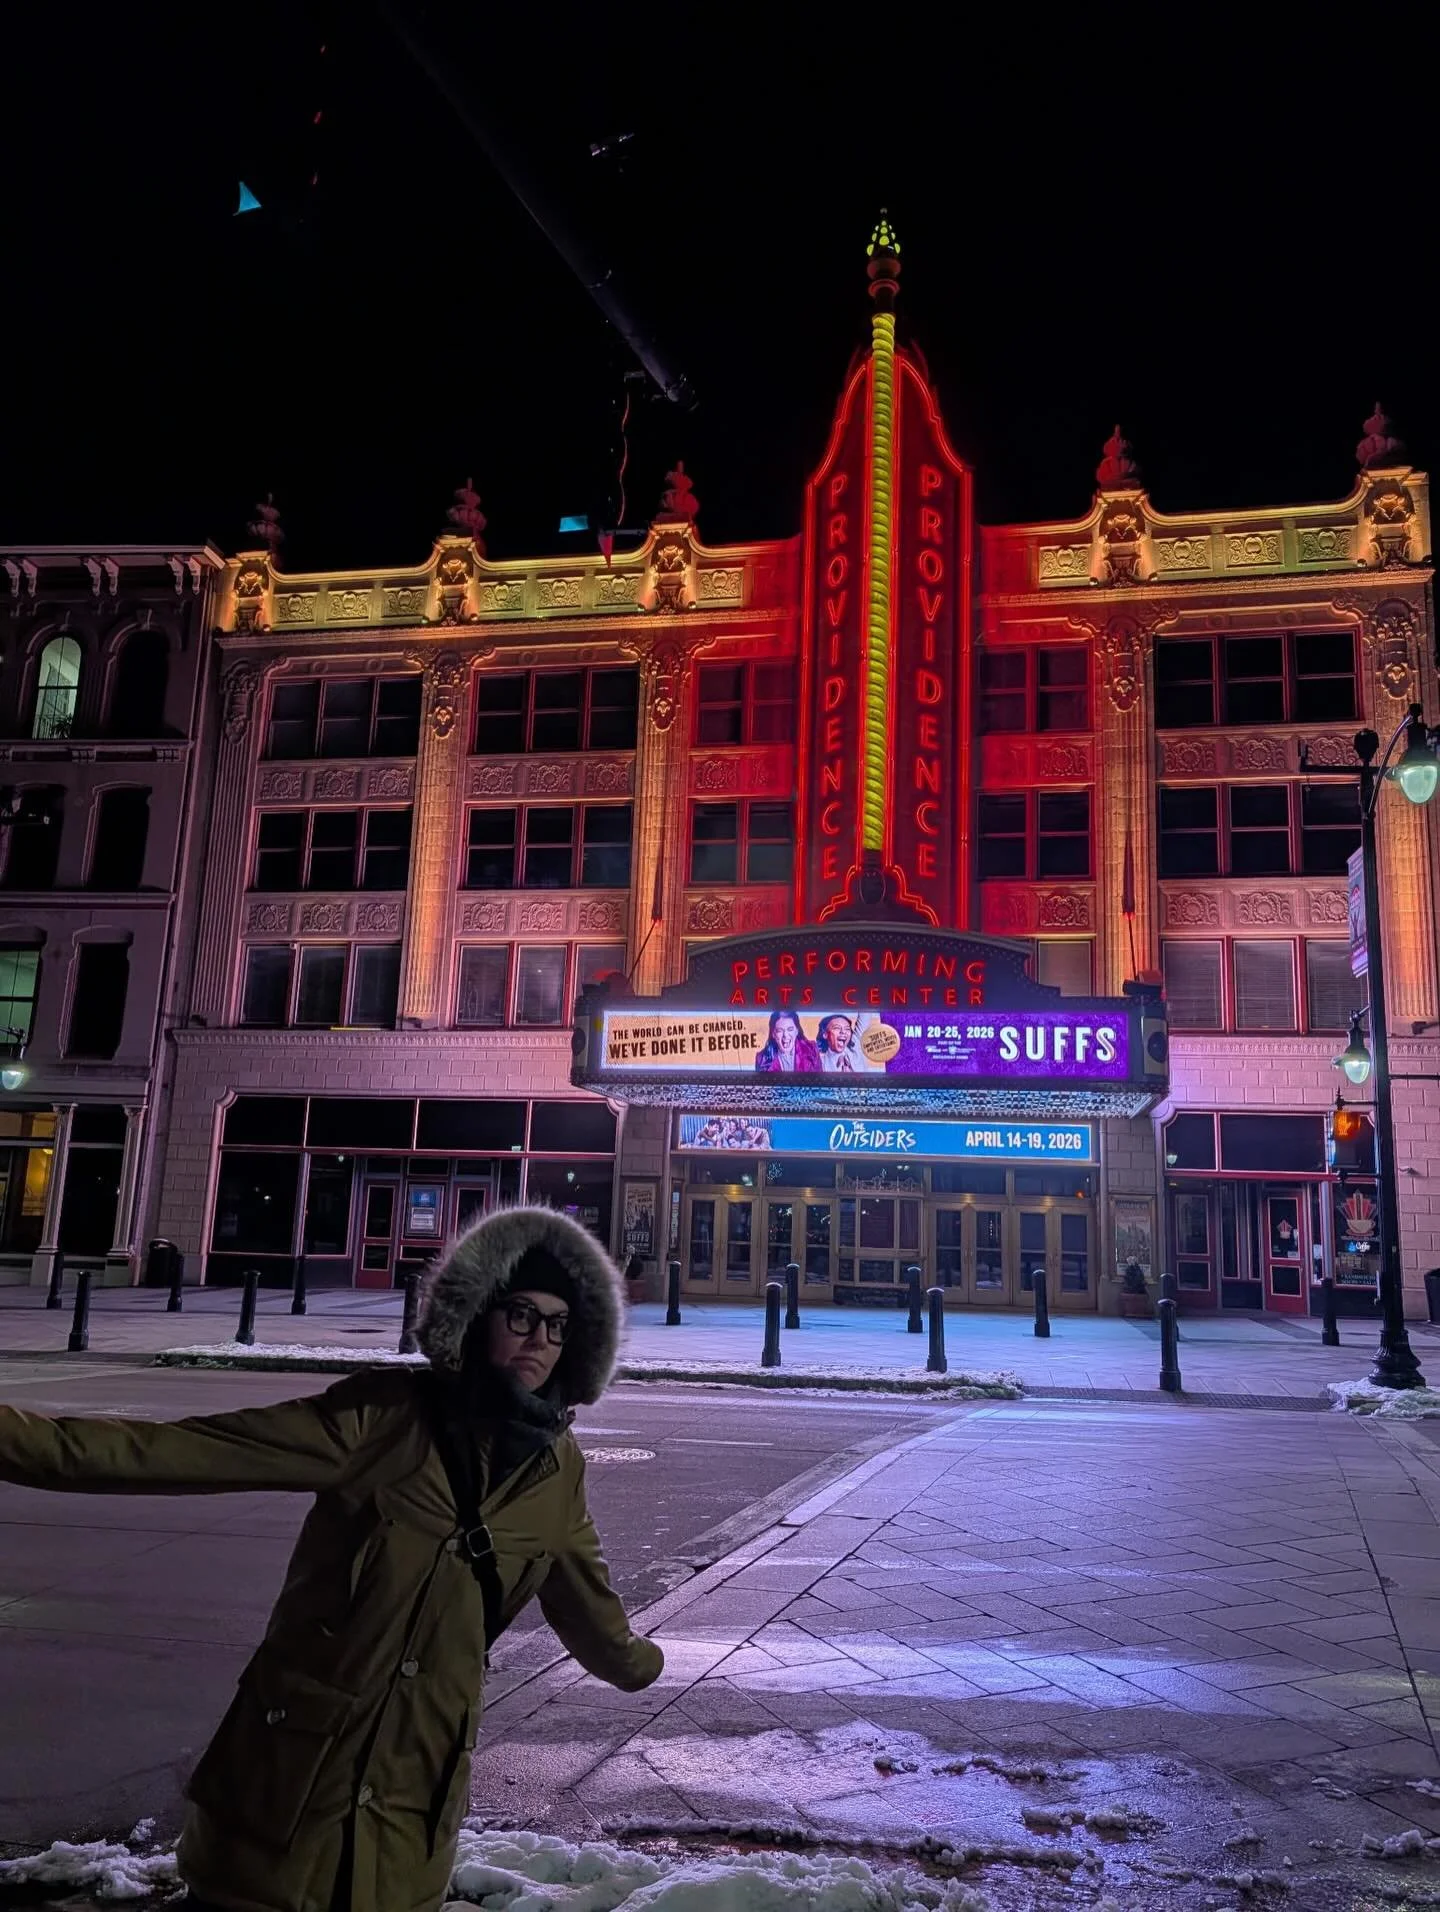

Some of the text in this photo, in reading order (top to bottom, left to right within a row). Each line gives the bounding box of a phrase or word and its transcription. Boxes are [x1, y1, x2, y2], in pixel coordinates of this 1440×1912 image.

[822, 472, 849, 879] PROVIDENCE
[916, 463, 943, 879] PROVIDENCE
[732, 950, 985, 984] PERFORMING
[731, 987, 984, 1006] ARTS CENTER
[613, 1020, 746, 1041] THE WORLD CAN BE CHANGED.
[904, 1025, 922, 1038] JAN
[966, 1026, 994, 1038] 2026
[609, 1033, 760, 1059] WE'VE DONE IT BEFORE.
[1000, 1026, 1117, 1062] SUFFS
[966, 1131, 1082, 1150] APRIL 14-19, 2026
